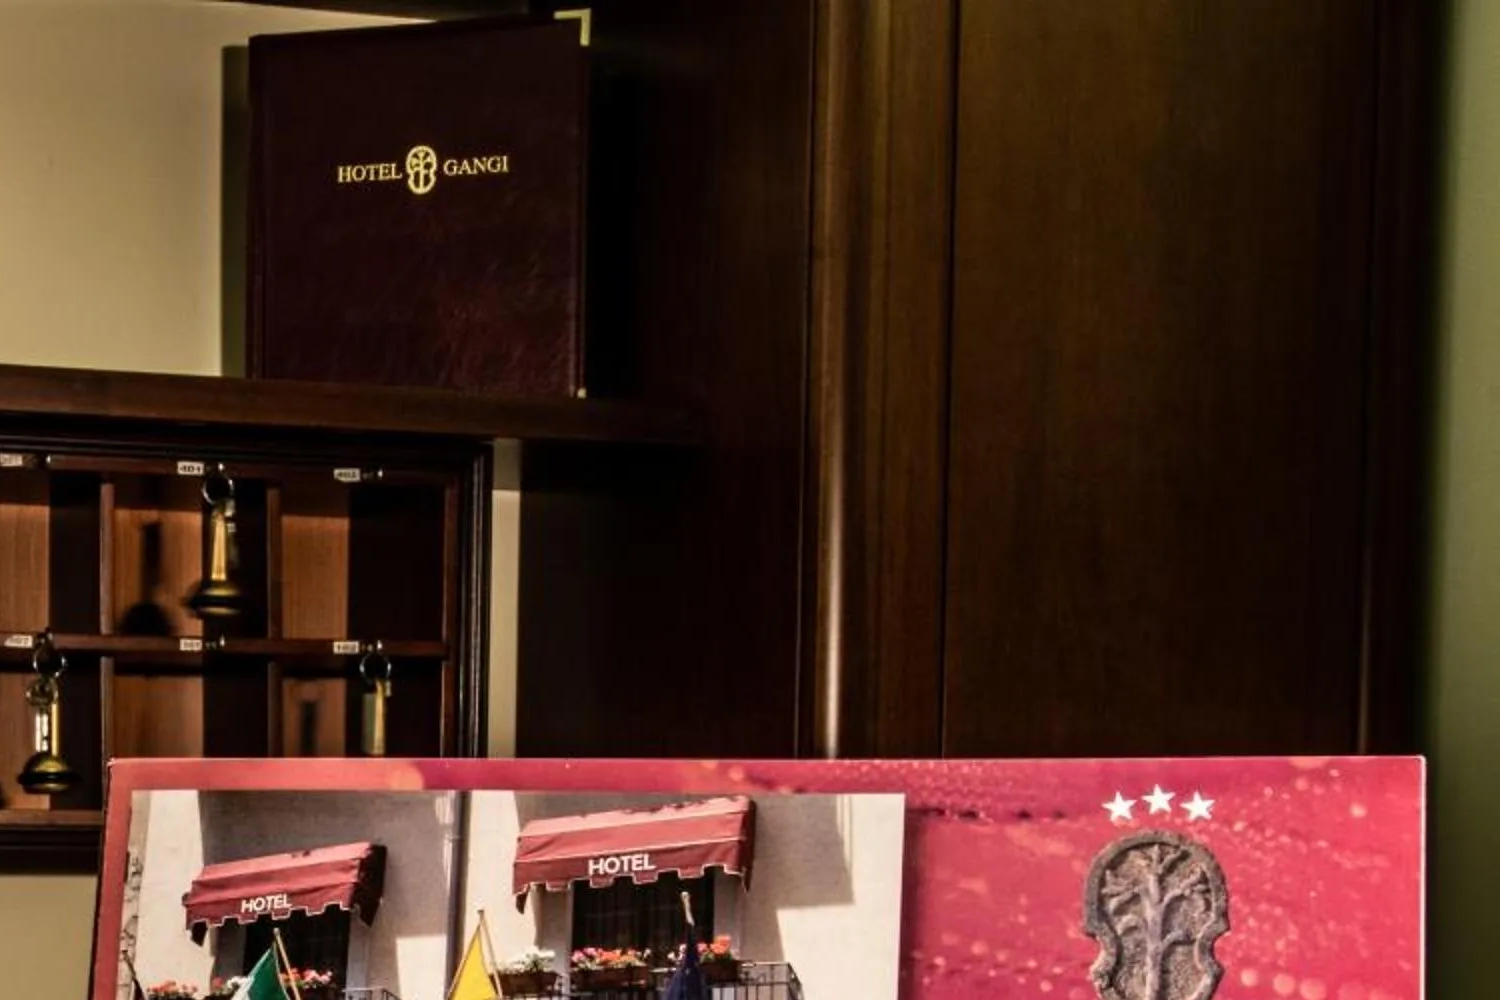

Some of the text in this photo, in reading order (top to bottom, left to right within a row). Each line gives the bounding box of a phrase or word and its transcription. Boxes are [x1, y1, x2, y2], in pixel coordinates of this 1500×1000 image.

[337, 155, 509, 183] HOTEL GANGI
[588, 854, 656, 876] HOTEL
[241, 893, 292, 914] HOTEL
